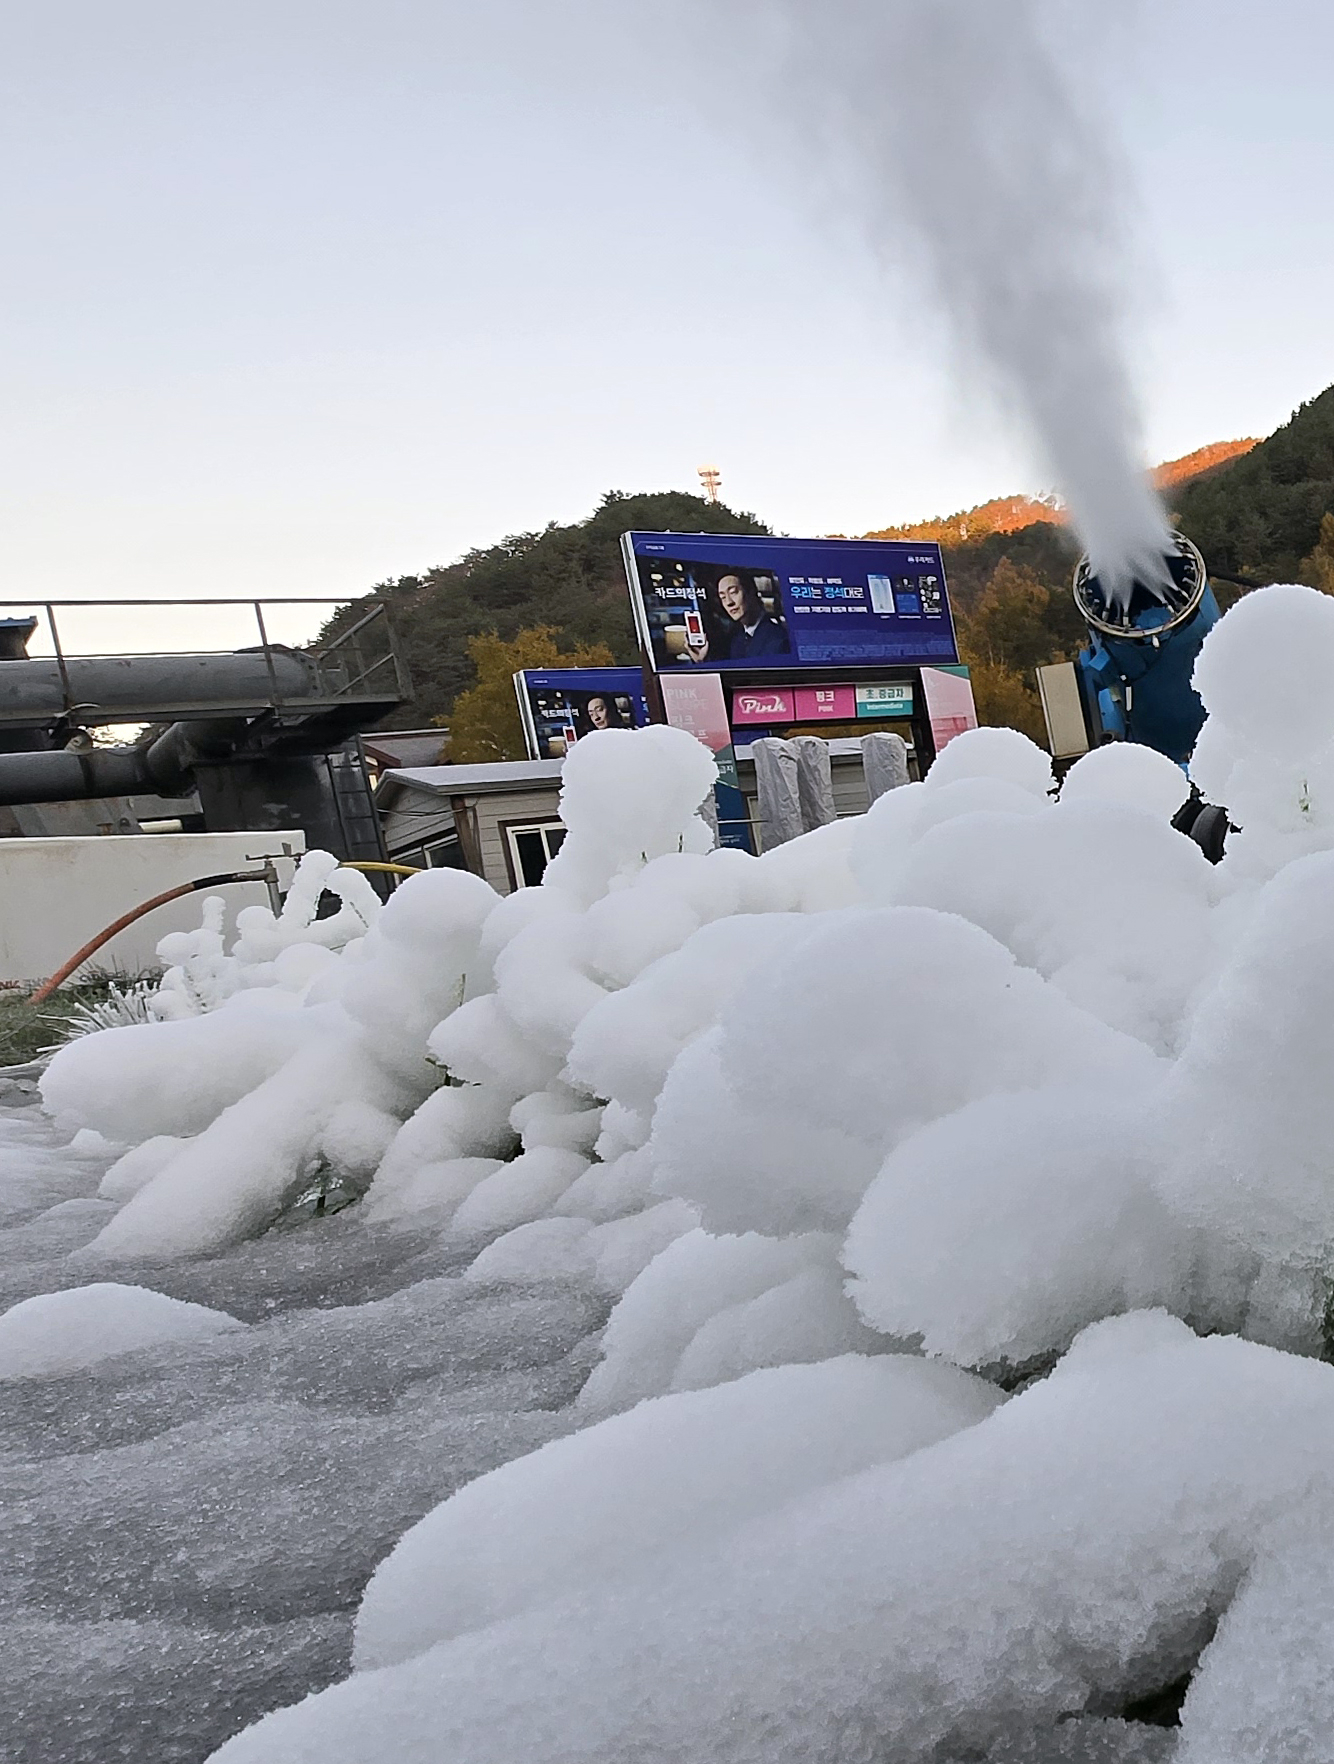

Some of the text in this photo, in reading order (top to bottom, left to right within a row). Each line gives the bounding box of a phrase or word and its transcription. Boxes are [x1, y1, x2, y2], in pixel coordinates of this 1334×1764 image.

[790, 586, 865, 599] 우리는 정석대로
[739, 695, 787, 714] Pink
